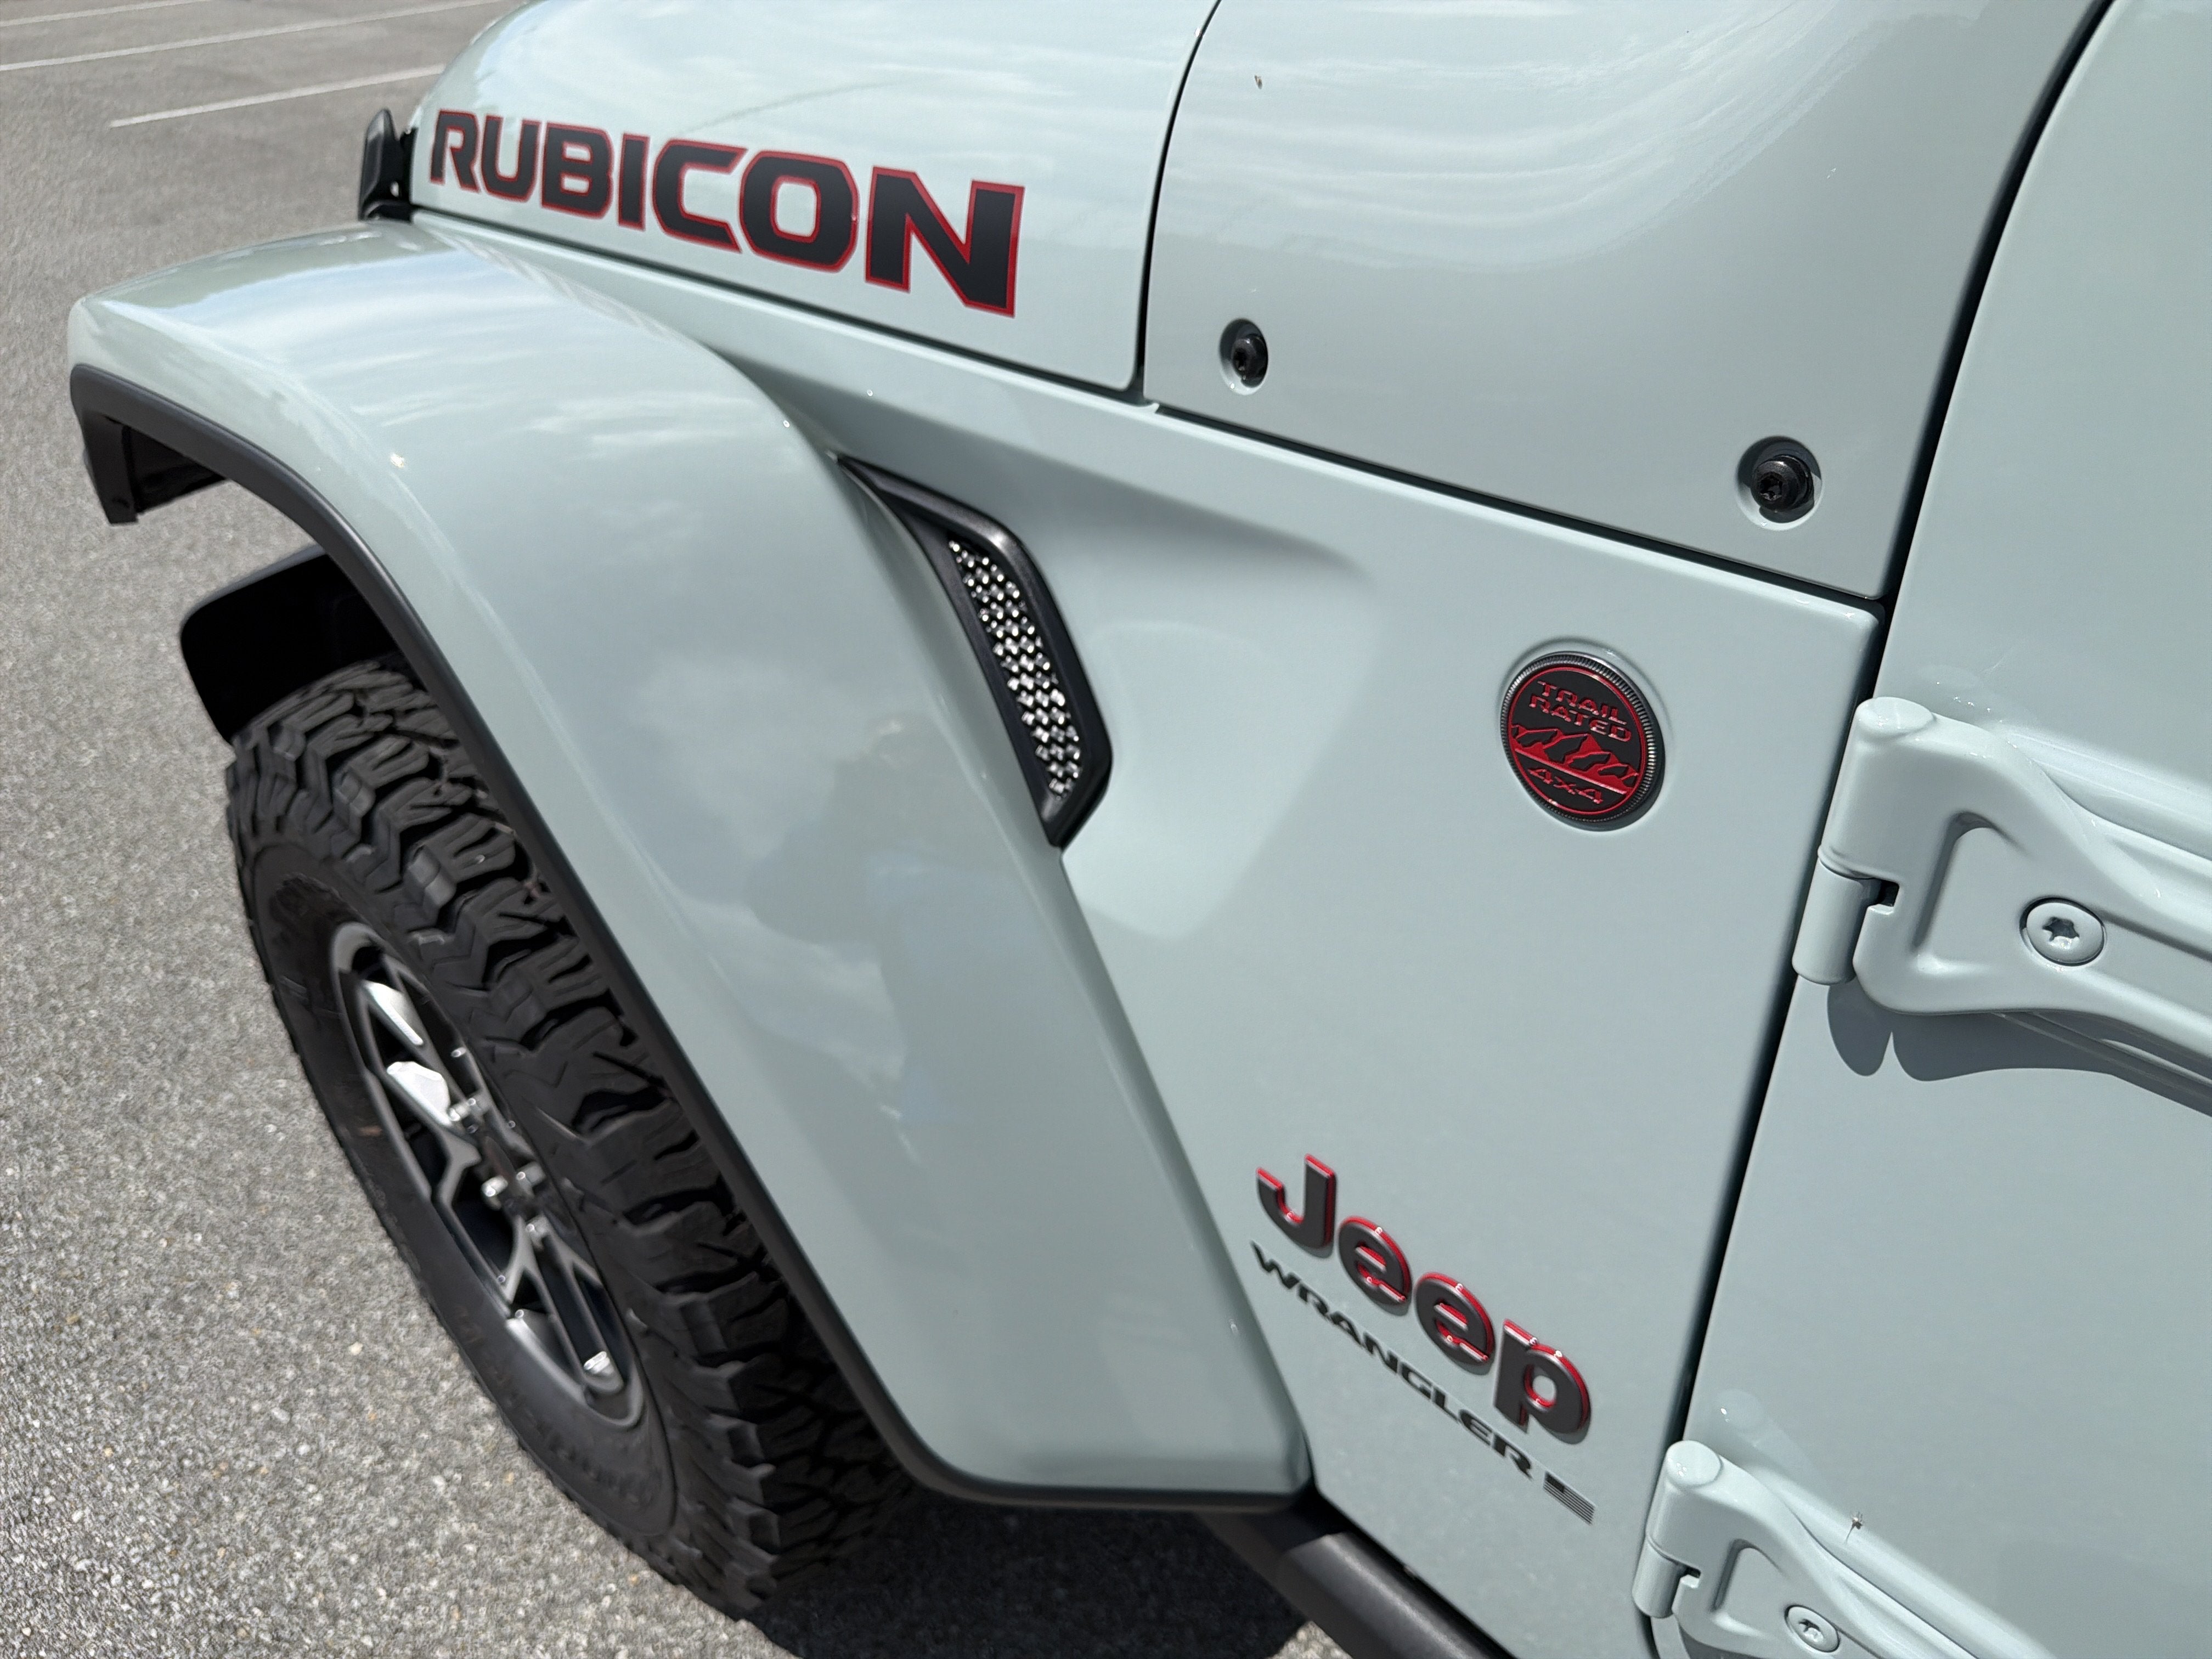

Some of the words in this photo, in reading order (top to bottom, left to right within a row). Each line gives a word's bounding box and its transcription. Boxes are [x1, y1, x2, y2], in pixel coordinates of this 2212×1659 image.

[430, 109, 1024, 318] RUBICON
[1529, 696, 1632, 742] RATED
[1537, 681, 1627, 725] TRAIL
[1250, 1240, 1534, 1482] WRANGLER
[1256, 1154, 1592, 1440] Jeep
